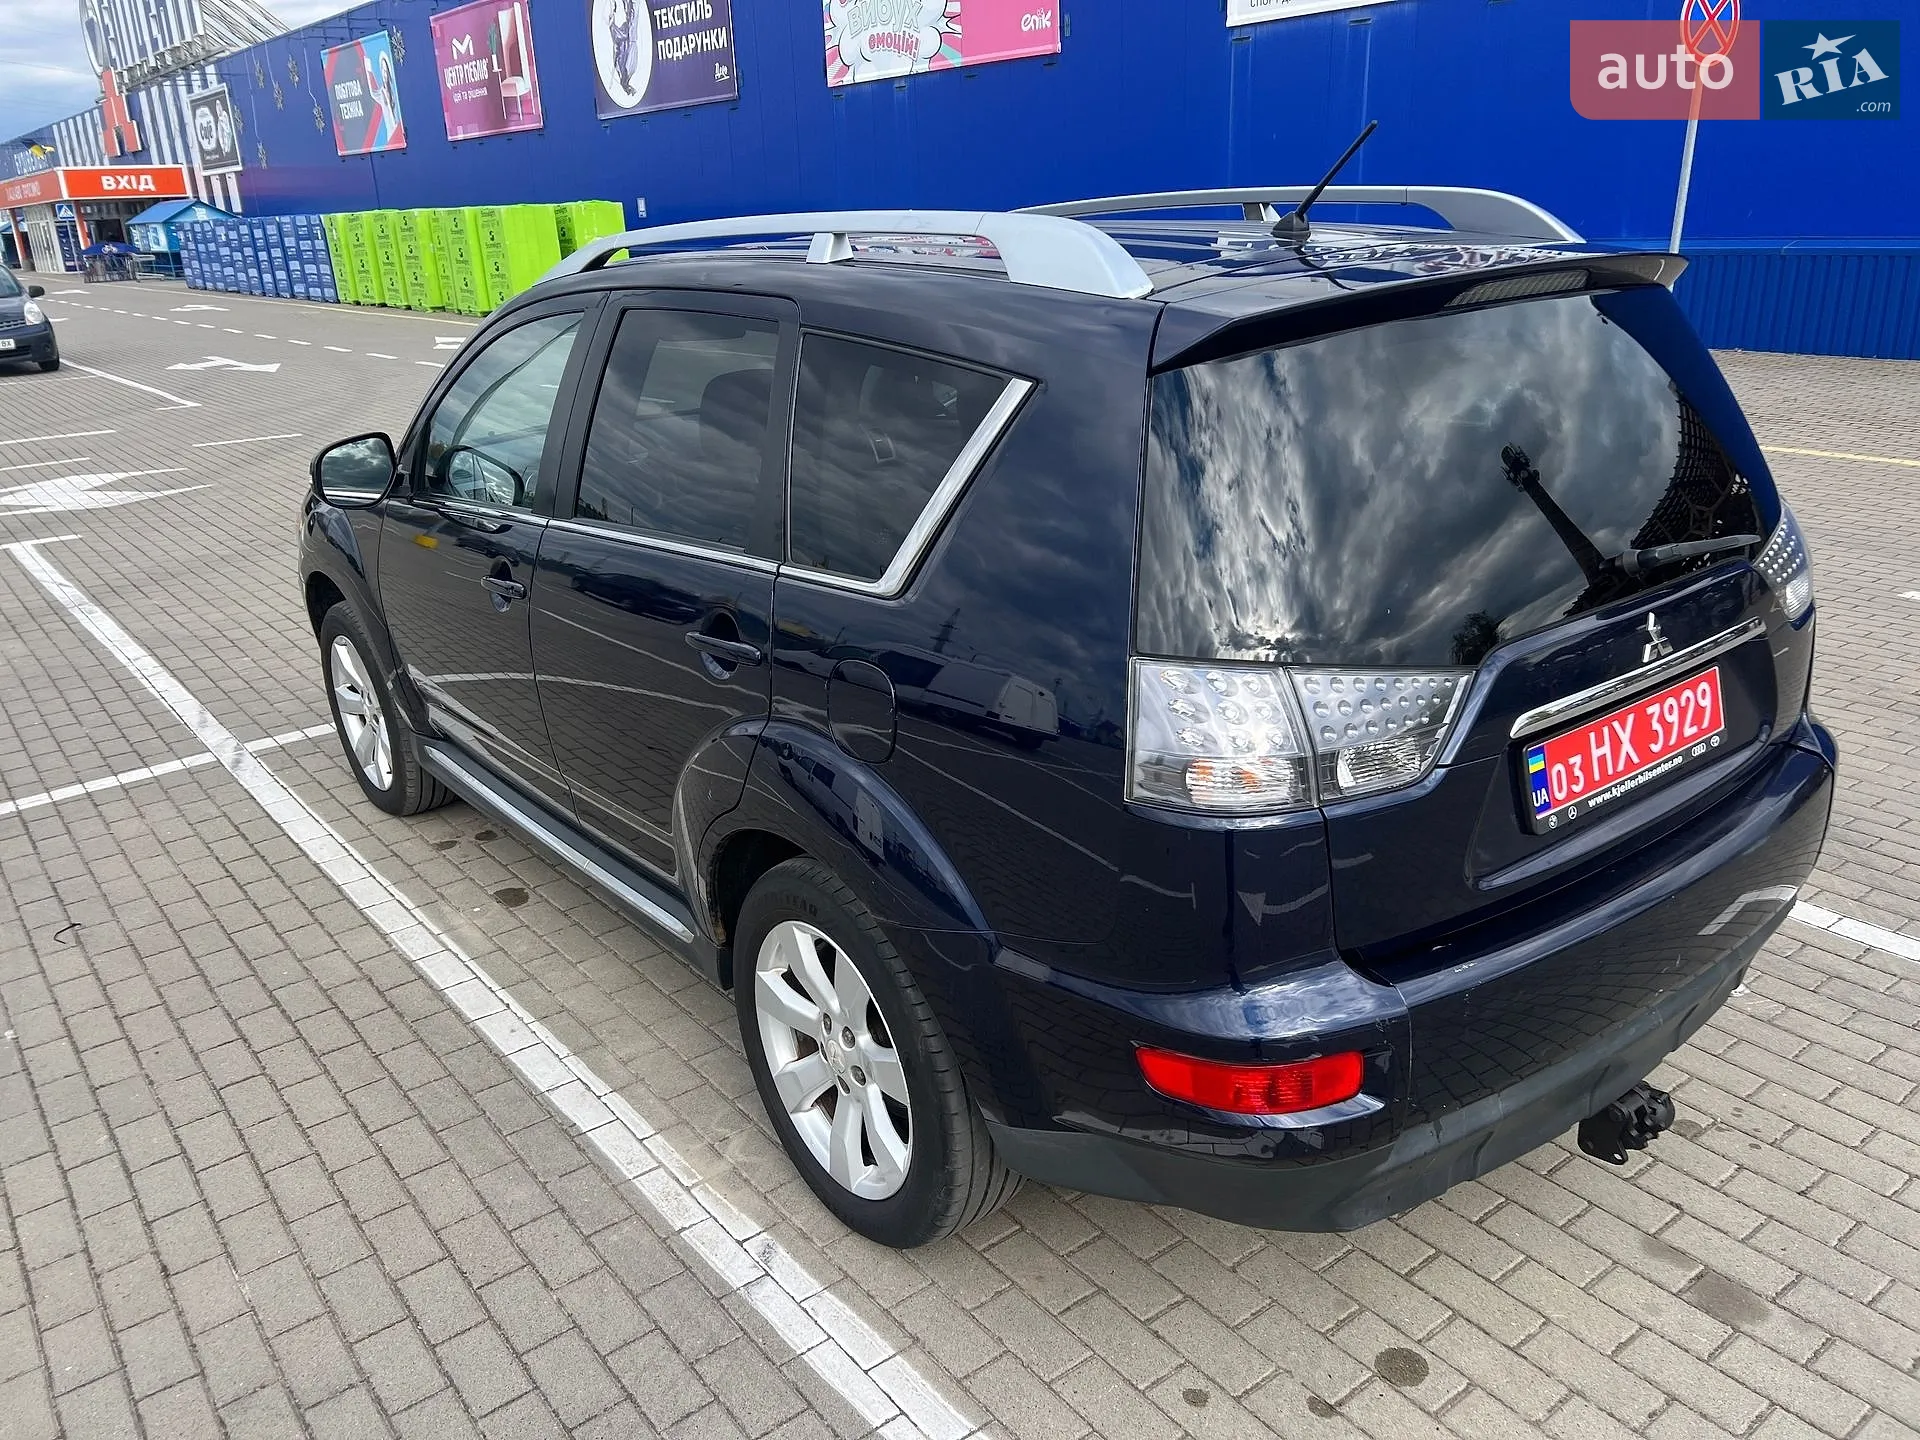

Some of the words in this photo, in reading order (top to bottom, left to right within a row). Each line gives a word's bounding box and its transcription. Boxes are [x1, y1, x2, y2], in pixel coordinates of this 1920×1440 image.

[654, 0, 712, 30] ТЕКСТИЛЬ
[657, 26, 728, 61] ПОДАРУНКИ
[444, 63, 464, 89] ЦЕНТР
[334, 79, 363, 100] ПОБУТОВА
[339, 100, 364, 120] ТЕХНІКА
[100, 174, 157, 192] ВХІД
[1551, 753, 1585, 802] 03
[1588, 712, 1640, 782] HX
[1645, 681, 1712, 753] 3929
[1587, 754, 1684, 808] www.kjellerbilsenter.no
[1532, 787, 1550, 808] UA
